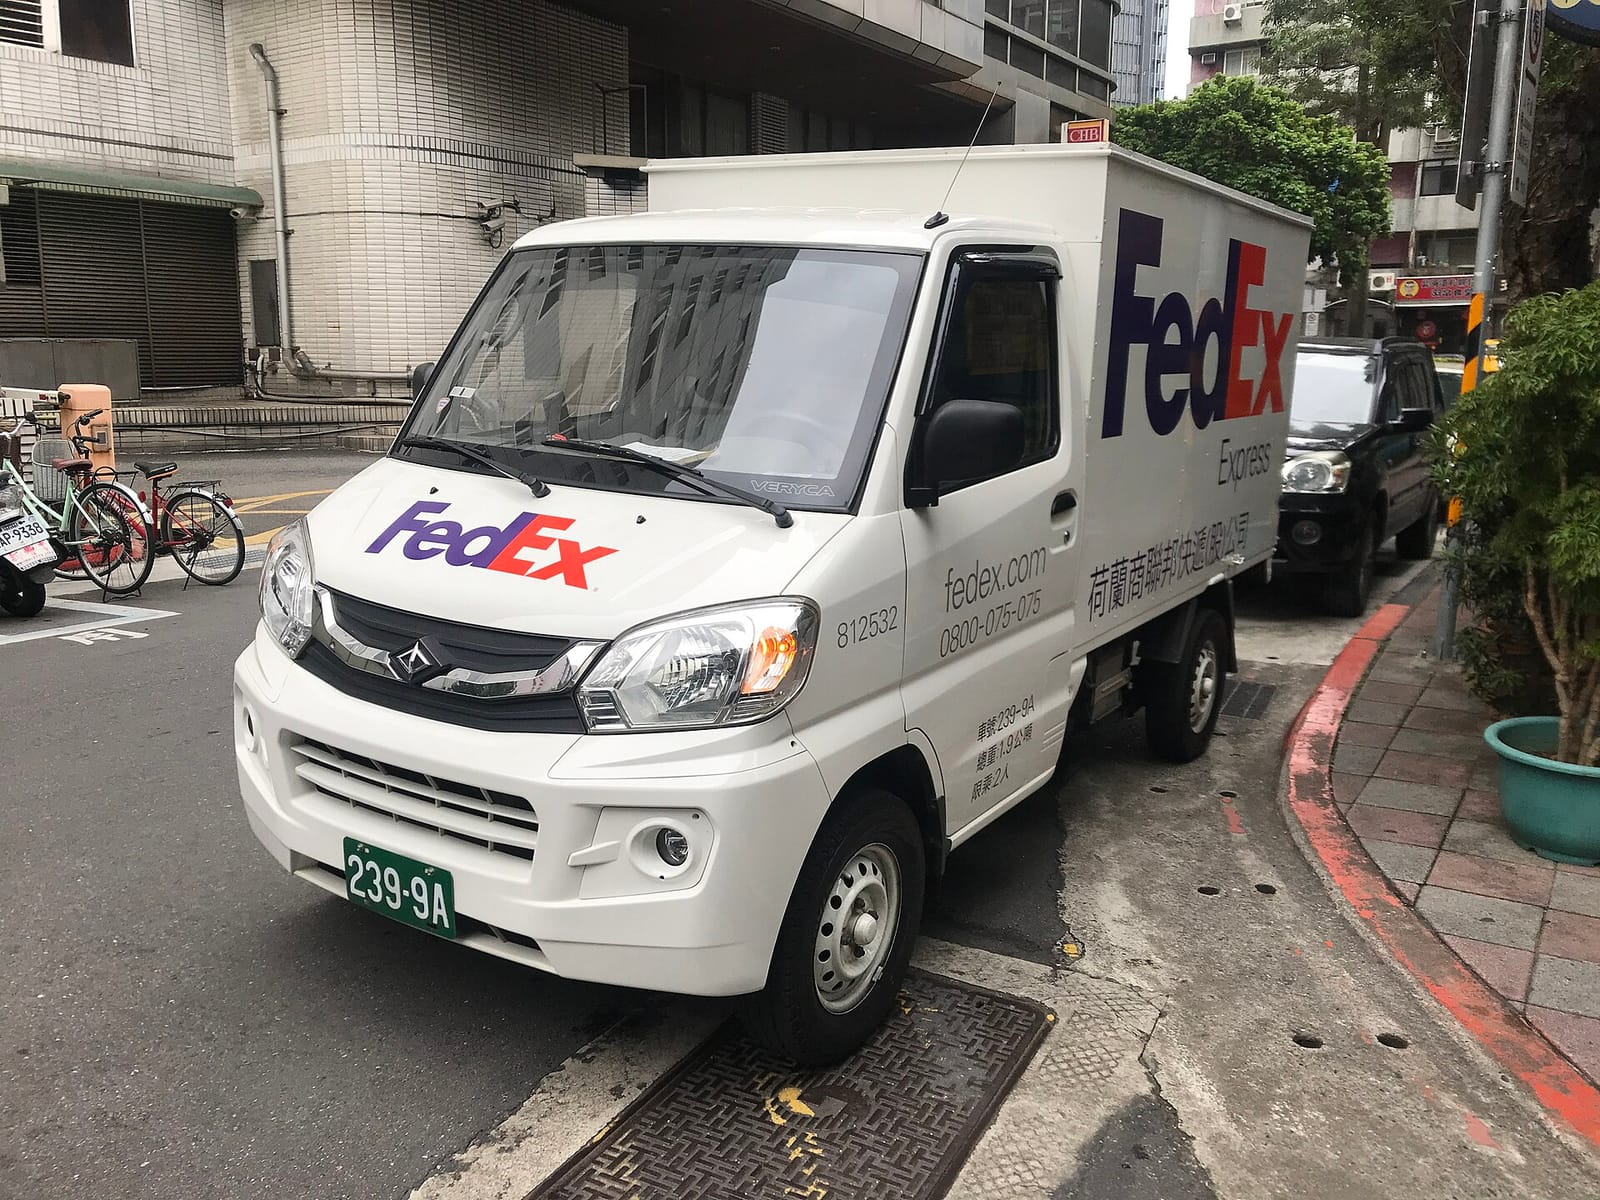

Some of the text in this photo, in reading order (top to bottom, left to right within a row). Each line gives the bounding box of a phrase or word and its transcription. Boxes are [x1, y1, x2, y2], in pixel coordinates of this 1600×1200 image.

[1070, 128, 1099, 142] CHB
[1102, 207, 1294, 439] FedEx
[751, 479, 836, 497] VERYCA
[1218, 438, 1272, 492] Express
[365, 500, 620, 590] FedEx
[945, 547, 1047, 613] fedex.com
[837, 605, 898, 648] 812532
[940, 589, 1042, 658] 0800-075-075
[348, 854, 450, 928] 239-9A
